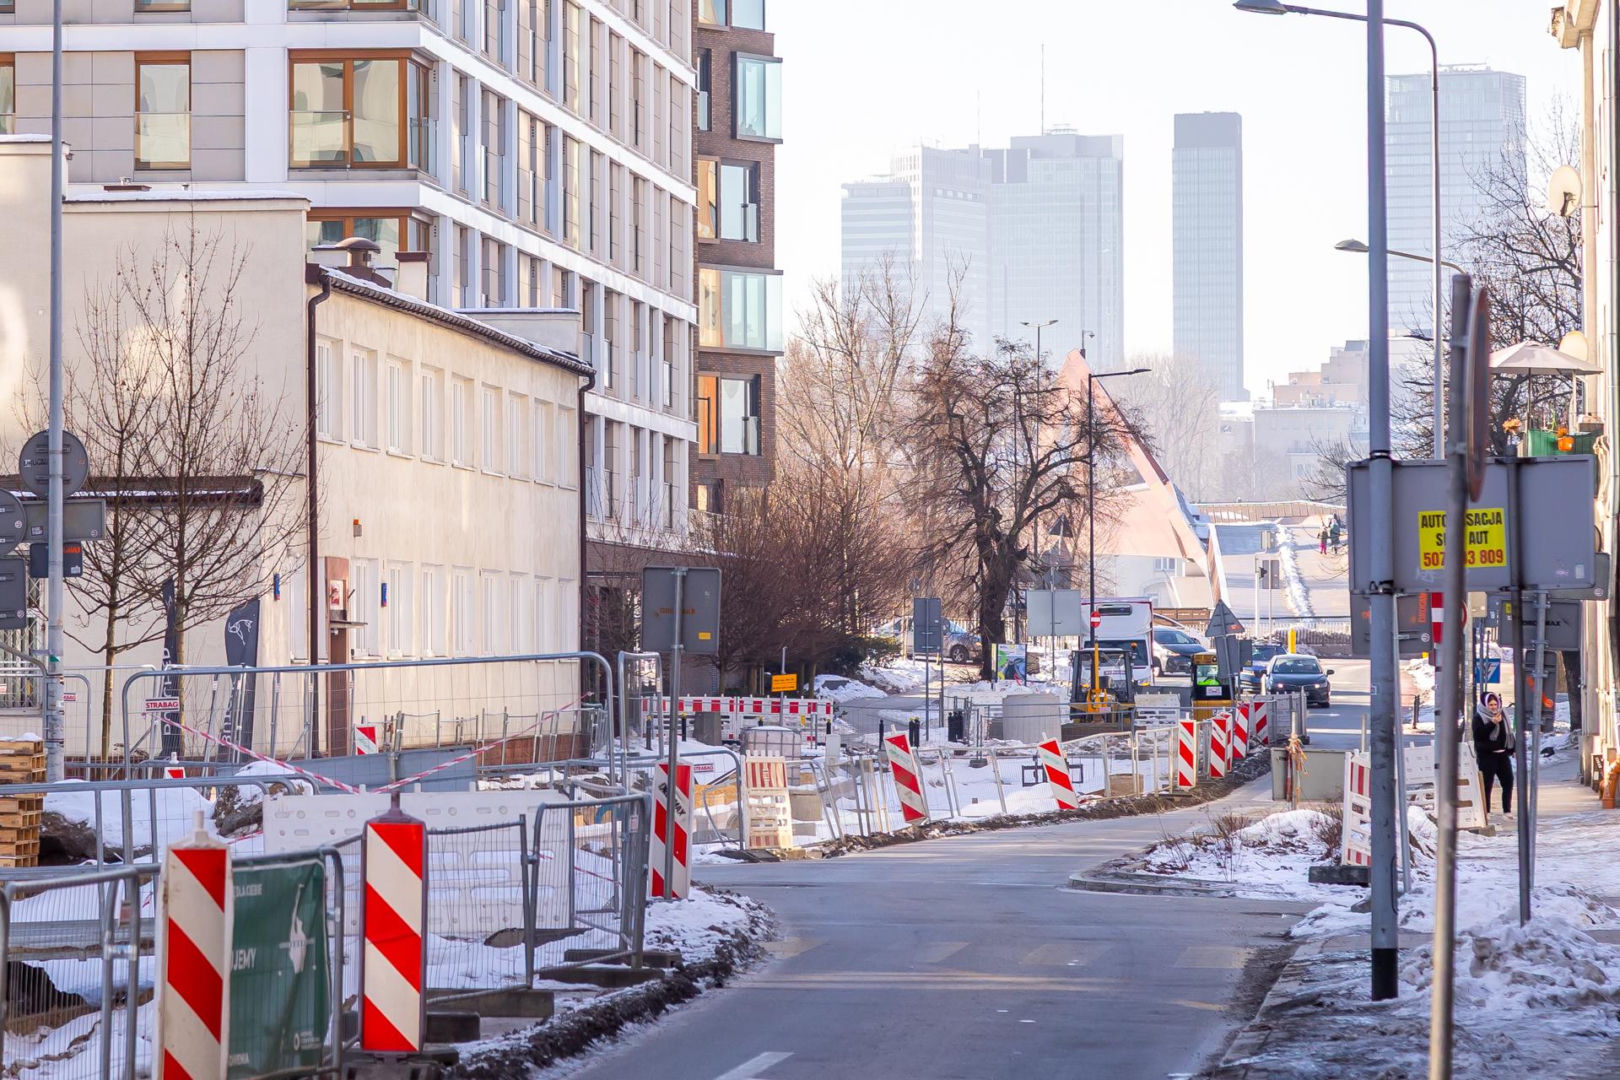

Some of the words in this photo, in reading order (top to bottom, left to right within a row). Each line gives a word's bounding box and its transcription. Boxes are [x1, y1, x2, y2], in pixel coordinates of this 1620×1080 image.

[1469, 531, 1488, 545] AUT
[1480, 549, 1504, 564] 809
[145, 701, 178, 709] STRABAG
